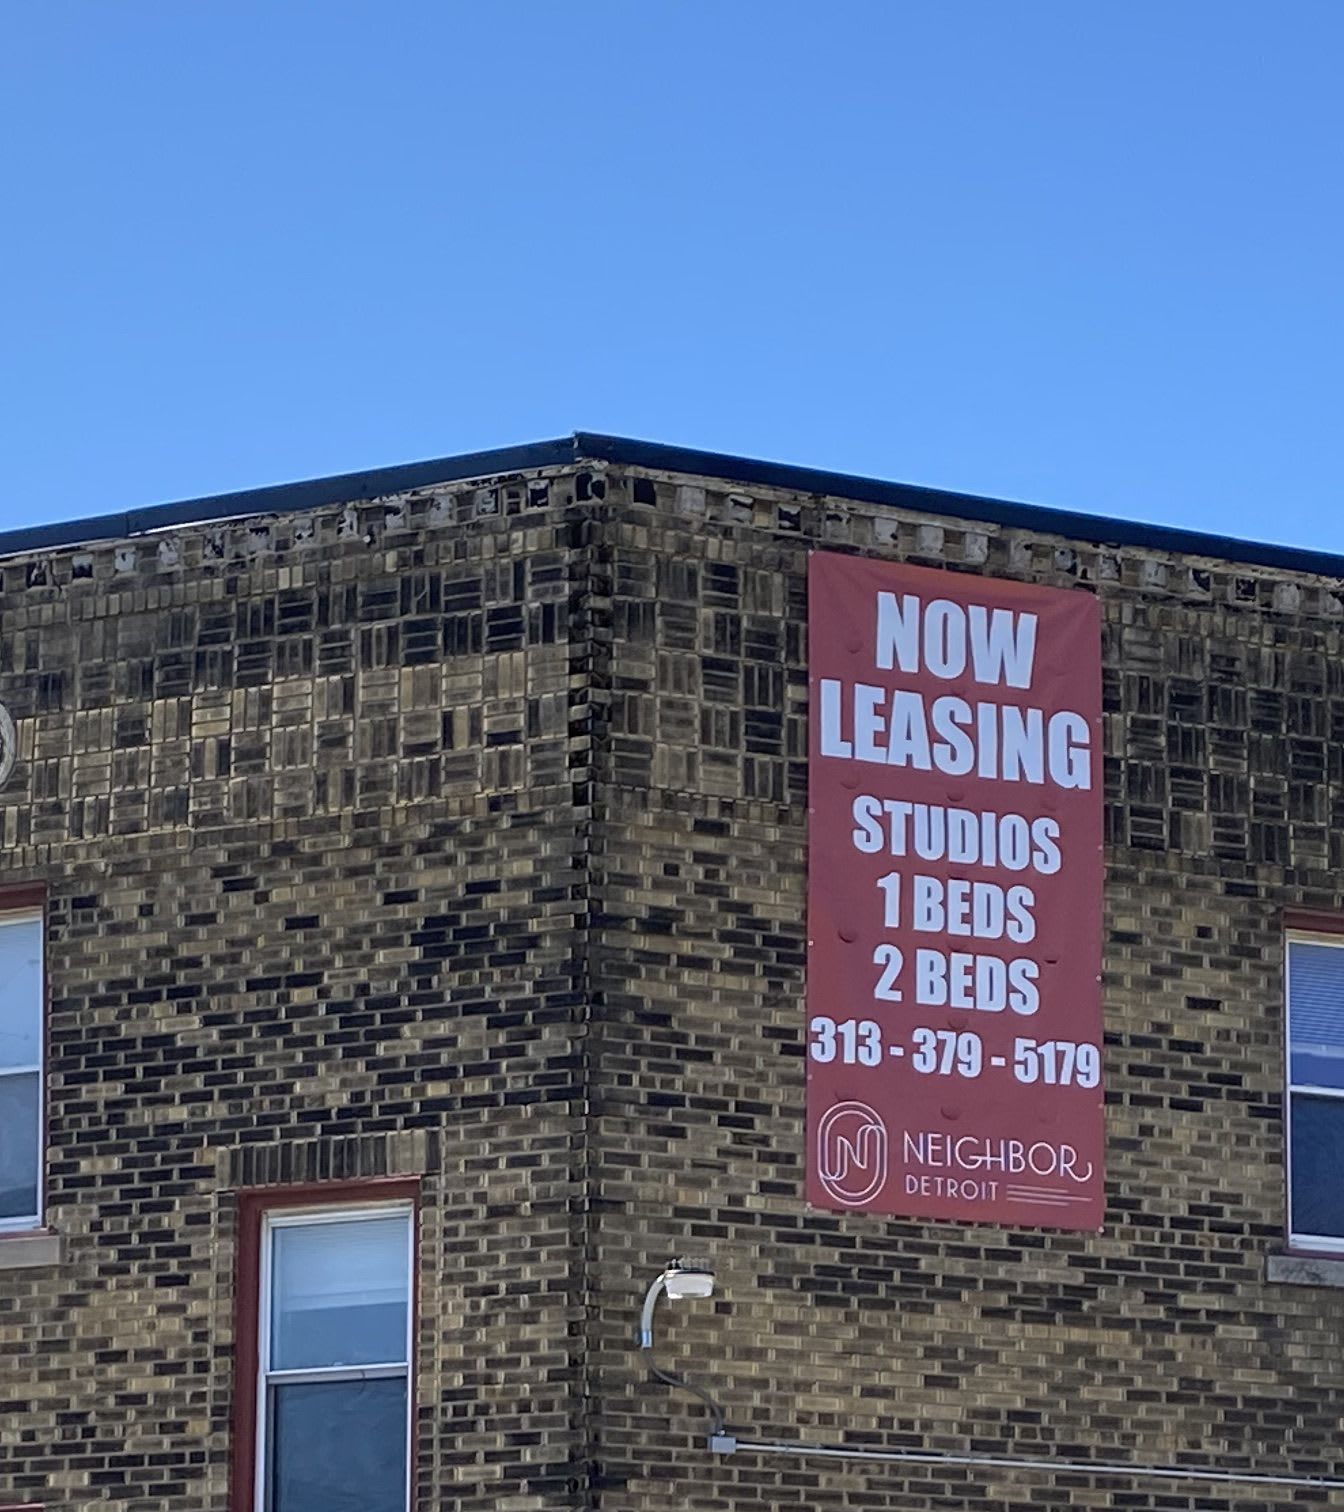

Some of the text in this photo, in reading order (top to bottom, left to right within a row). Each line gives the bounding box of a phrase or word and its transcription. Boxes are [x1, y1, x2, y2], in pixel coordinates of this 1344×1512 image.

[876, 591, 1038, 690] NOW
[820, 678, 1092, 790] LEASING
[852, 795, 1062, 875] STUDIOS
[876, 871, 1036, 944] 1 BEDS
[872, 943, 1040, 1016] 2 BEDS
[903, 1130, 1093, 1183] NEIGHBOR
[905, 1174, 999, 1201] DETROIT
